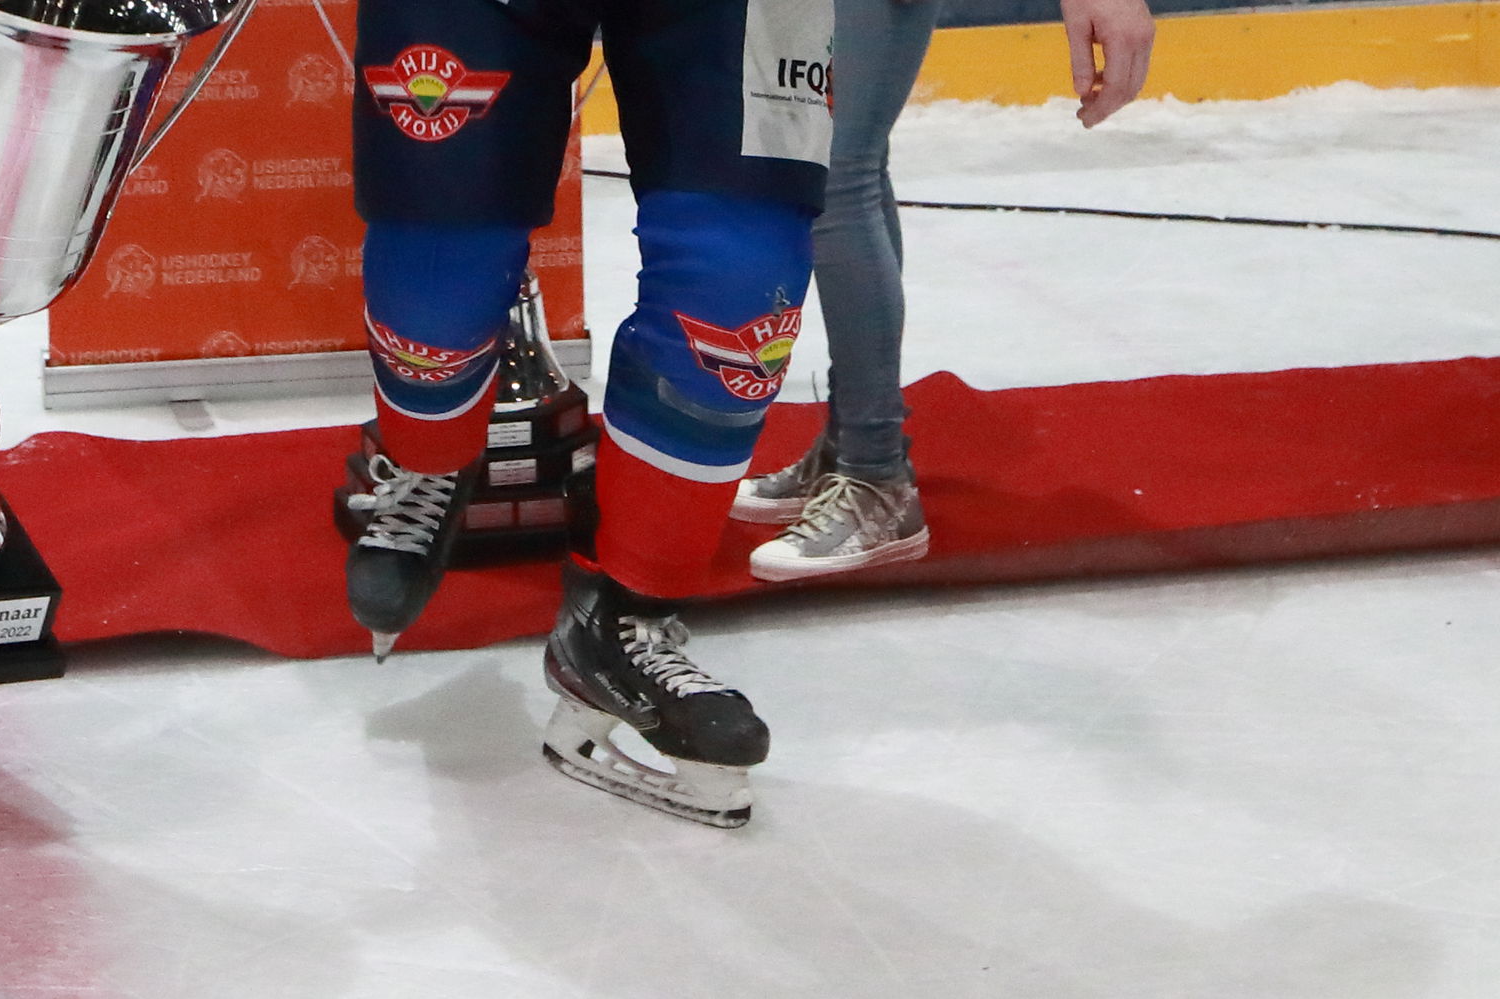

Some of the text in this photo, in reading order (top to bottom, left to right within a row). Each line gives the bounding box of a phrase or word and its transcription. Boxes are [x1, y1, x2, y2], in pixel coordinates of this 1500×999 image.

[401, 52, 457, 79] HIJS
[398, 110, 459, 137] HOKIJ
[0, 625, 32, 639] 2022
